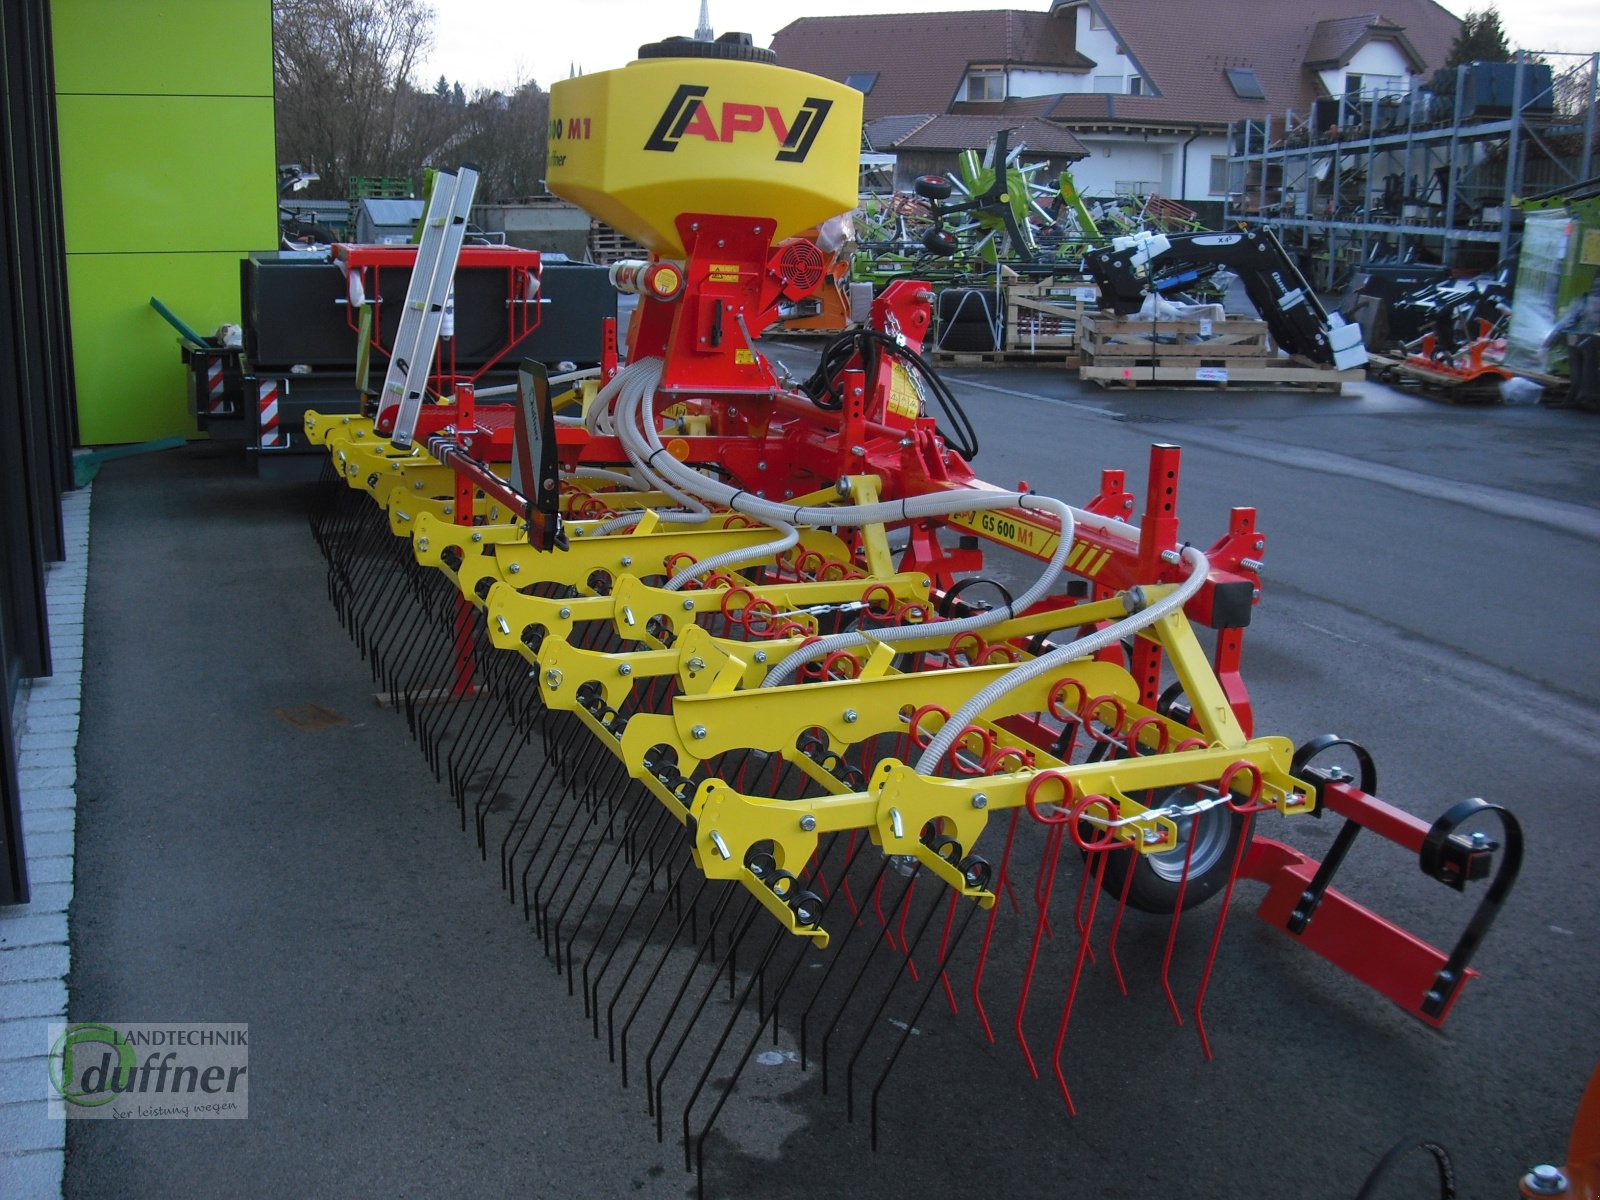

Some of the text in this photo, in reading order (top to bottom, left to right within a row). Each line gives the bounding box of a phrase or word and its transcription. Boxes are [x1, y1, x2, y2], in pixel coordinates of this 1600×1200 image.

[568, 118, 591, 139] M1
[982, 514, 995, 531] GS
[997, 519, 1015, 539] 600
[1017, 527, 1033, 547] M1
